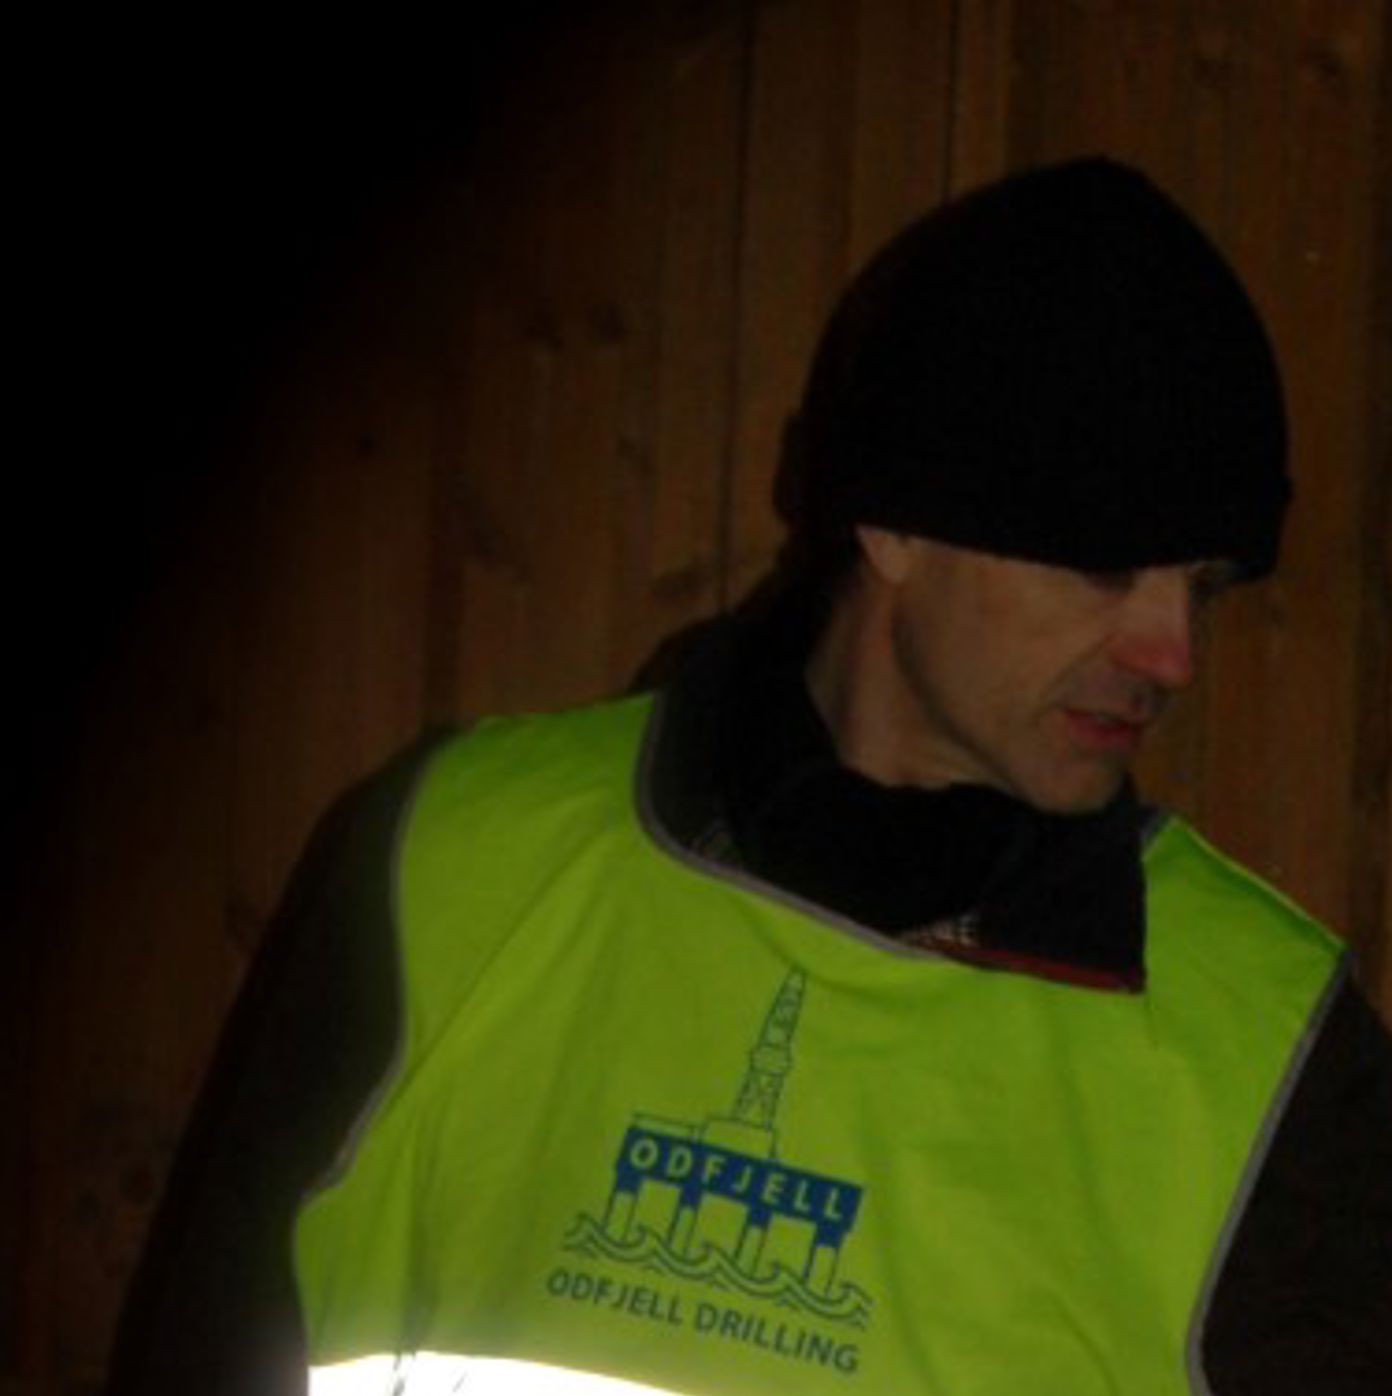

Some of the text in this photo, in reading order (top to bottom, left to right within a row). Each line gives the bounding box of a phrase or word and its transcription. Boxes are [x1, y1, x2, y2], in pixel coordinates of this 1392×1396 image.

[628, 1138, 842, 1221] ODFJELL
[547, 1269, 860, 1374] ODFJELL DRILLING
